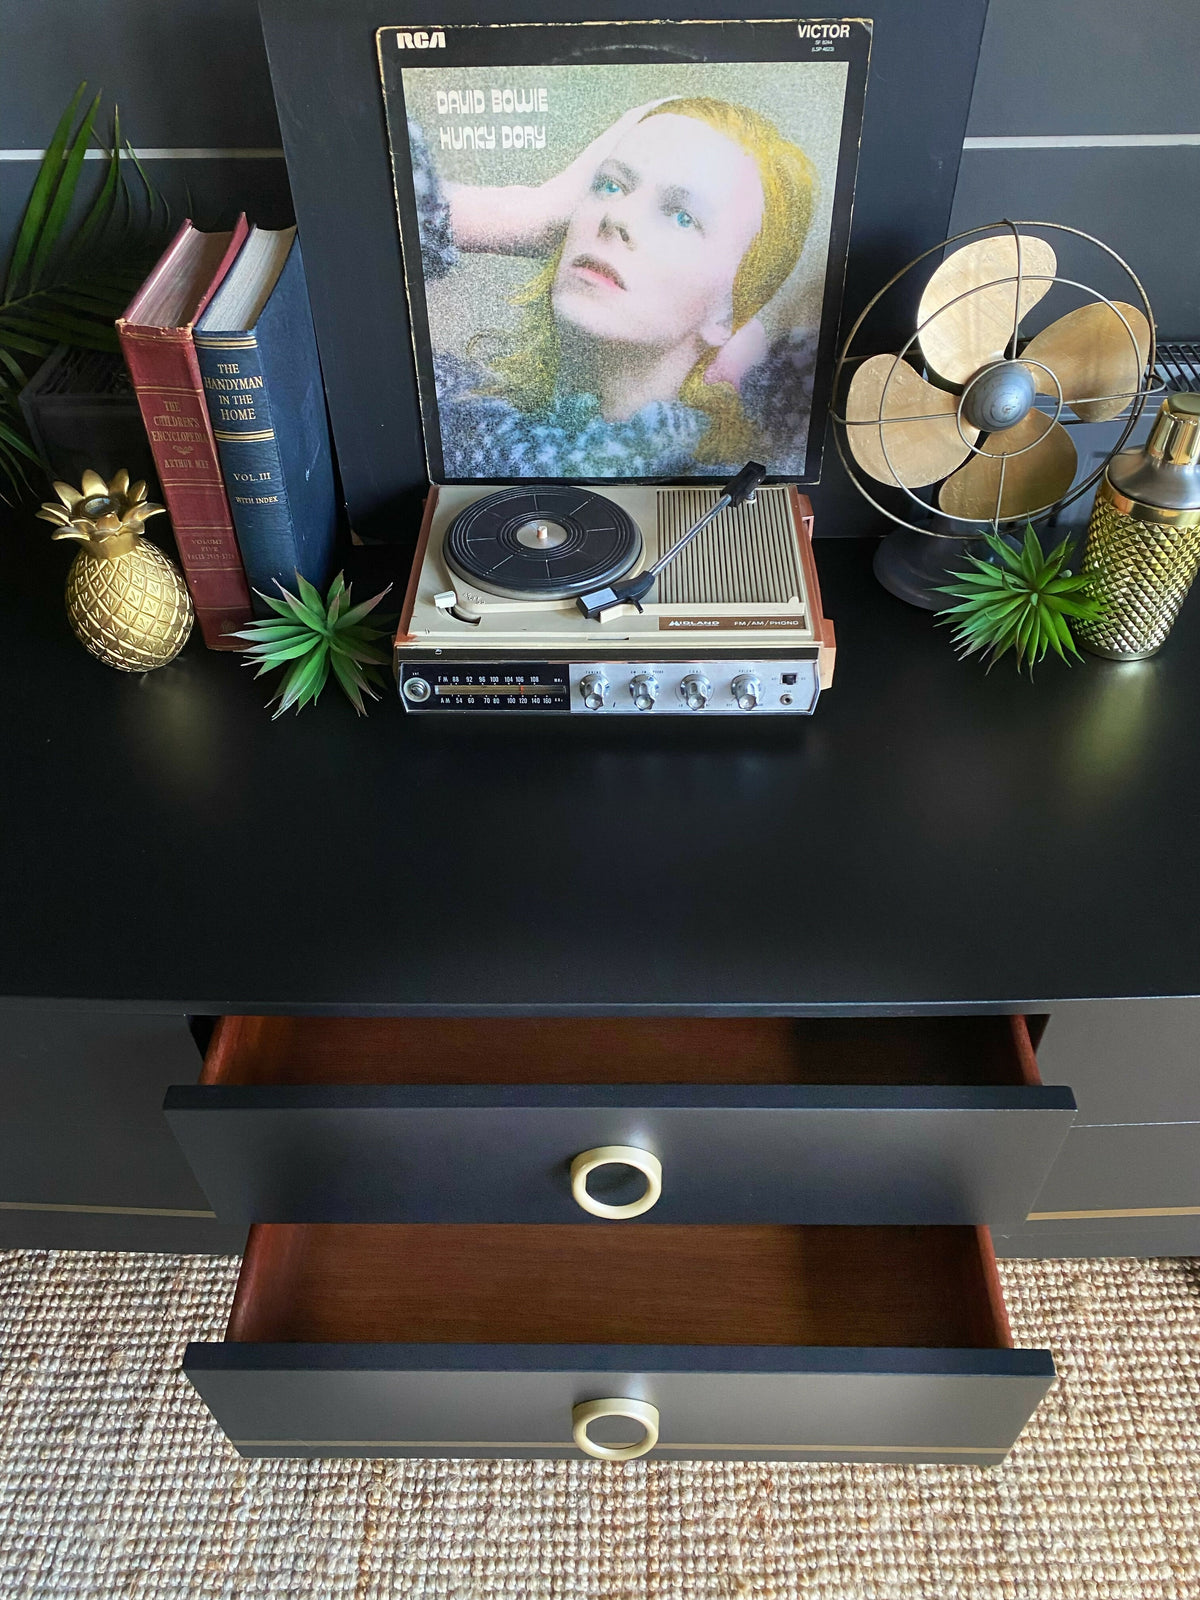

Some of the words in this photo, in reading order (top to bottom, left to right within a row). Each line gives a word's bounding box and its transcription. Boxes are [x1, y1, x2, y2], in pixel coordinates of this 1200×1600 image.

[797, 24, 851, 39] VICTOR
[396, 32, 446, 49] RCA
[437, 90, 485, 114] DAVID
[492, 88, 548, 113] BOWIE
[440, 126, 497, 150] HUNKY
[502, 125, 547, 149] DORY
[217, 363, 240, 375] THE
[203, 376, 264, 391] HANDYMAN
[163, 401, 181, 412] THE
[219, 395, 230, 405] IN
[232, 394, 254, 405] THE
[220, 408, 256, 421] HOME
[235, 496, 254, 504] WITH
[255, 496, 279, 504] INDEX
